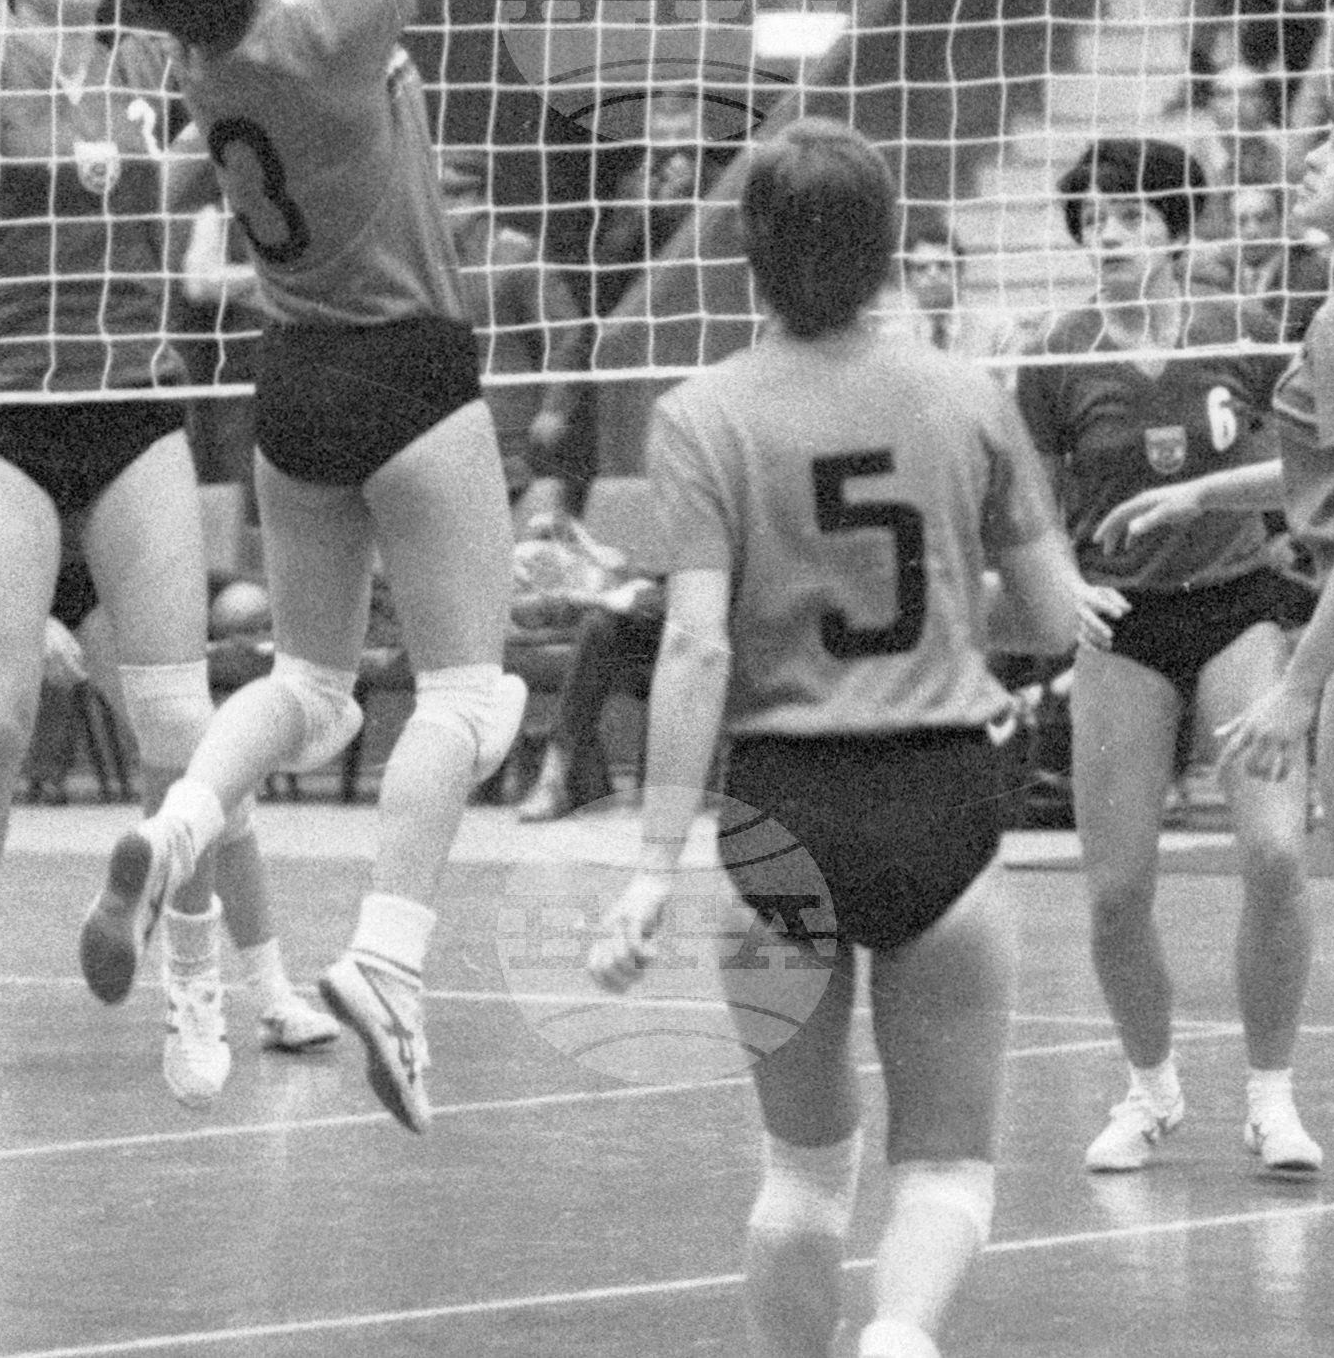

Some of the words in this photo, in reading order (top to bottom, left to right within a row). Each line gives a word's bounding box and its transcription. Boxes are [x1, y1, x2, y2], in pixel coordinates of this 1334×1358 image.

[207, 116, 311, 264] 3
[1207, 386, 1237, 452] 6
[812, 449, 926, 659] 5
